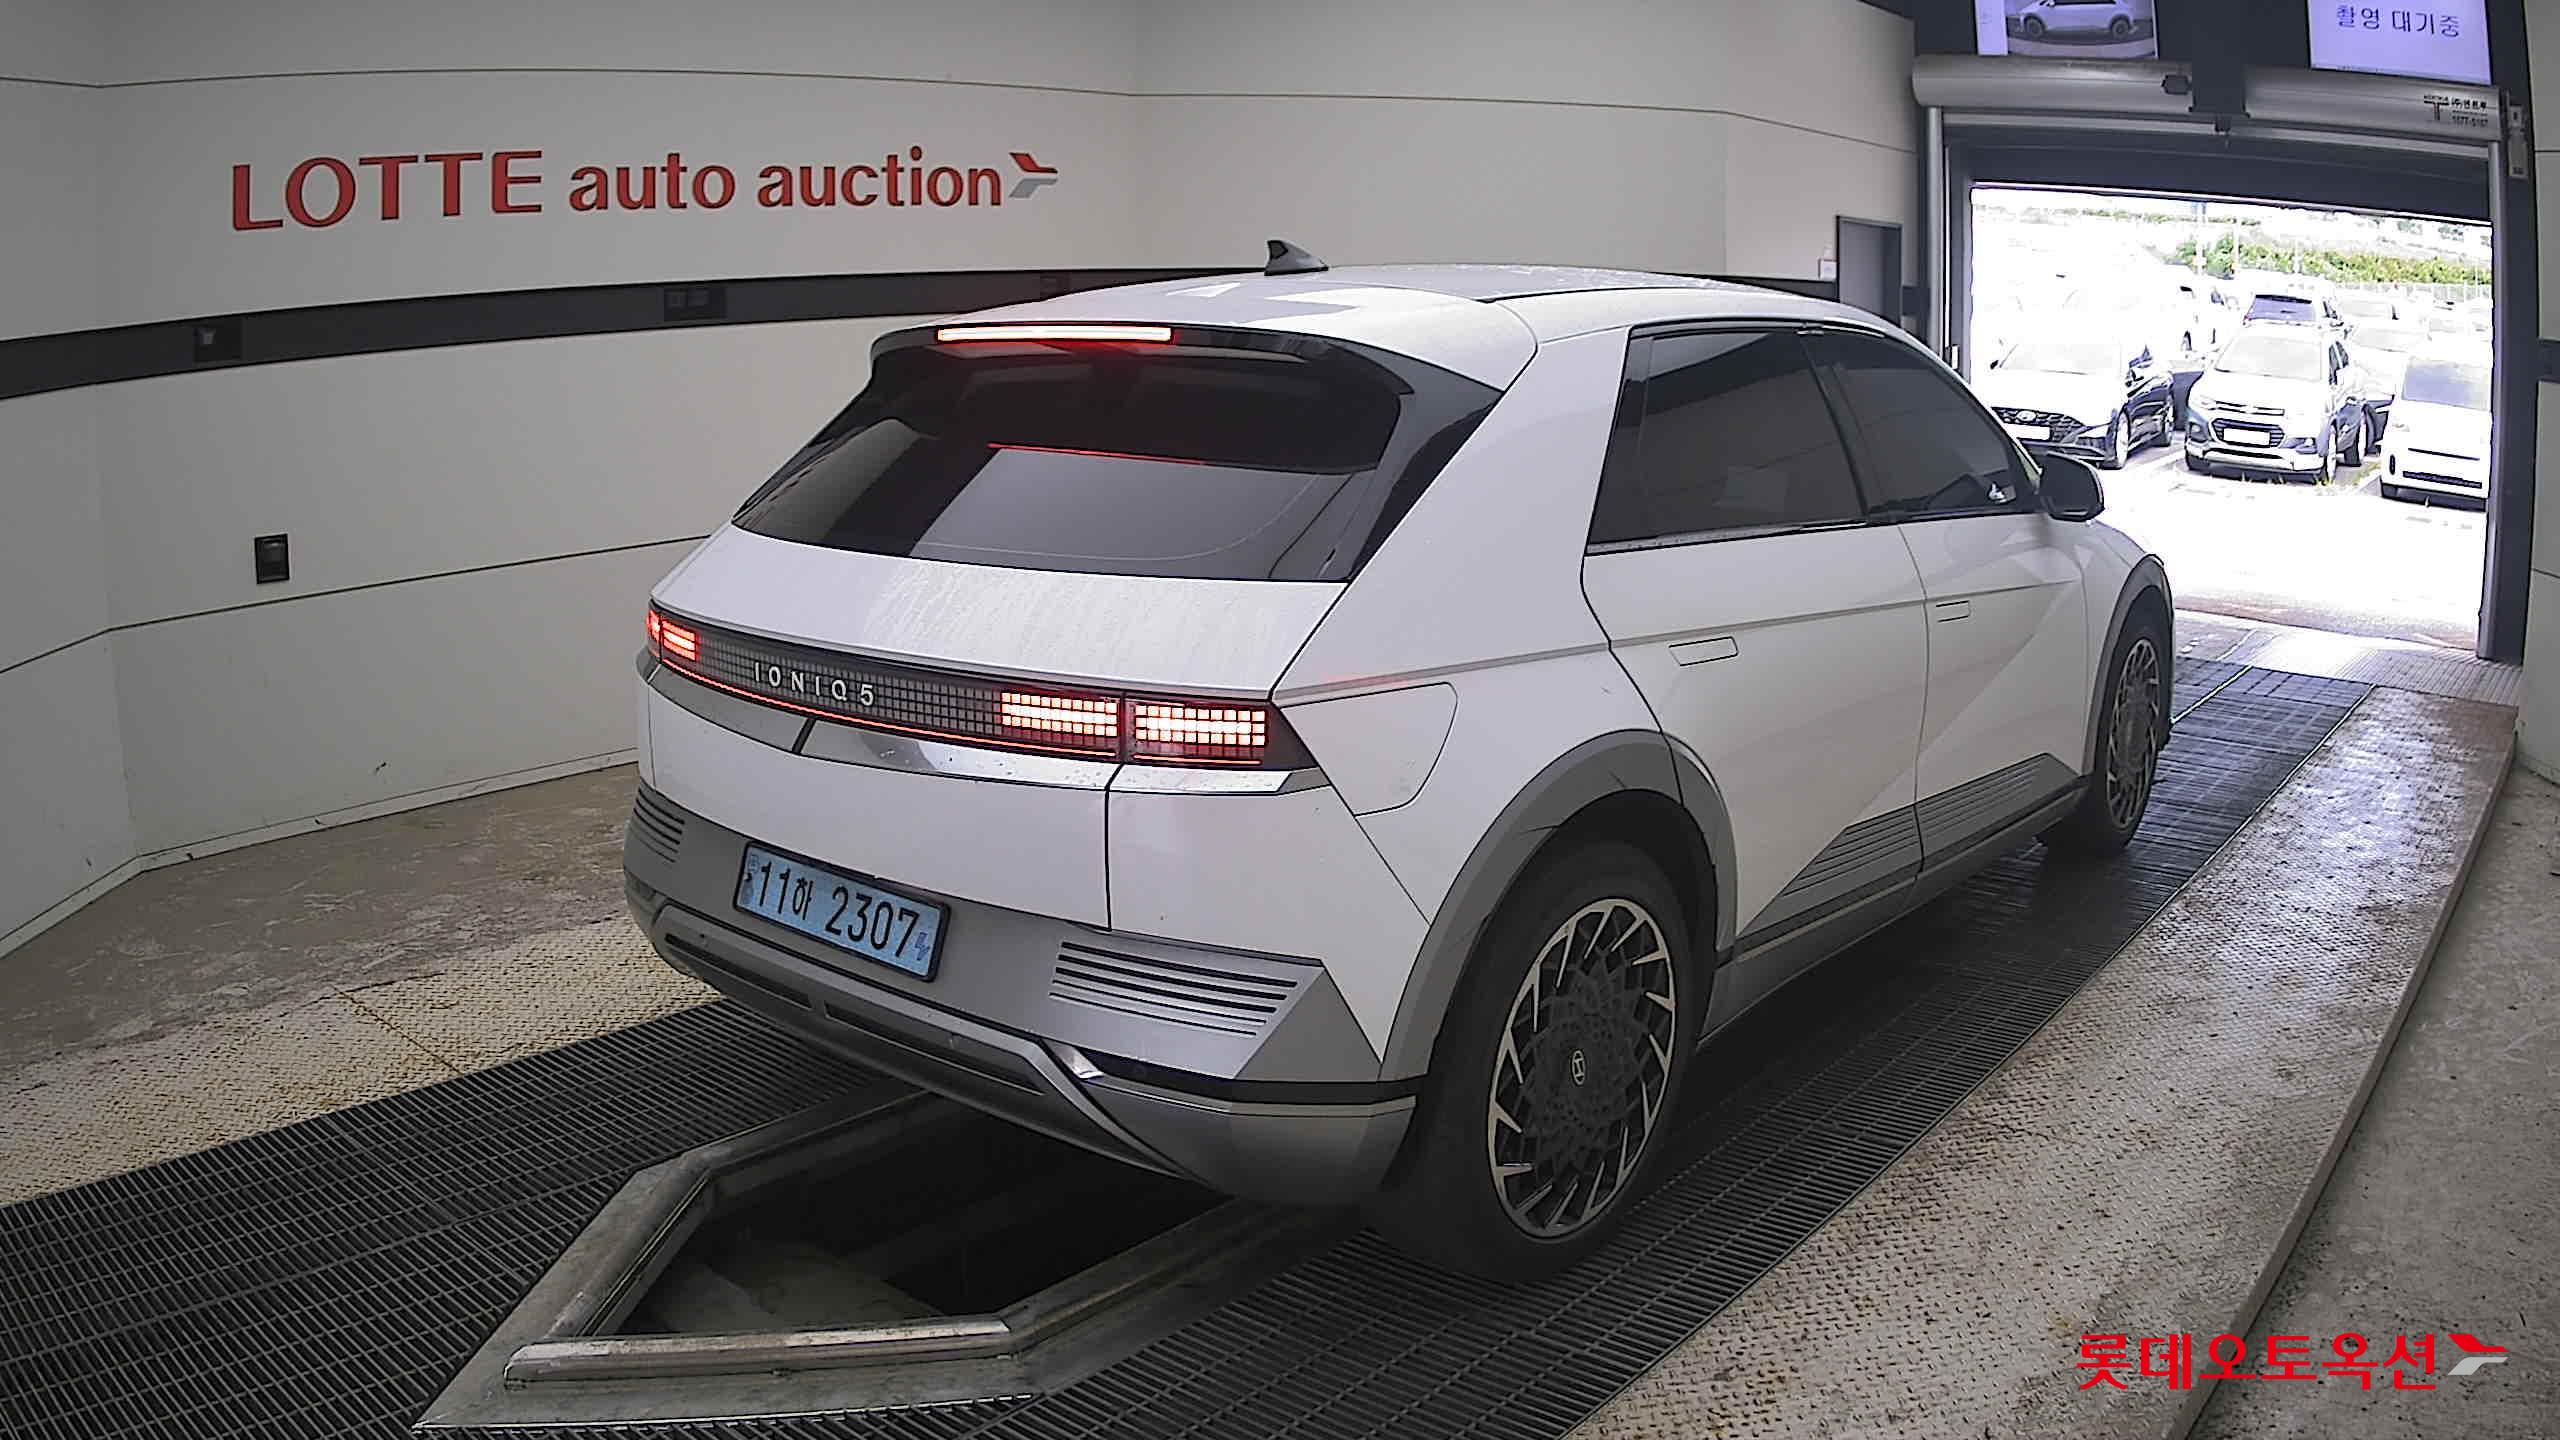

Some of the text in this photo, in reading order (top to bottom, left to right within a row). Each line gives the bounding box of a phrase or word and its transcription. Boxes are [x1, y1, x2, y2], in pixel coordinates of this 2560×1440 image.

[2336, 5, 2460, 39] 촬영 대기중
[233, 147, 1004, 231] LOTTE auto auction
[754, 662, 875, 706] IONIQ 5
[759, 860, 921, 958] 11하 2307
